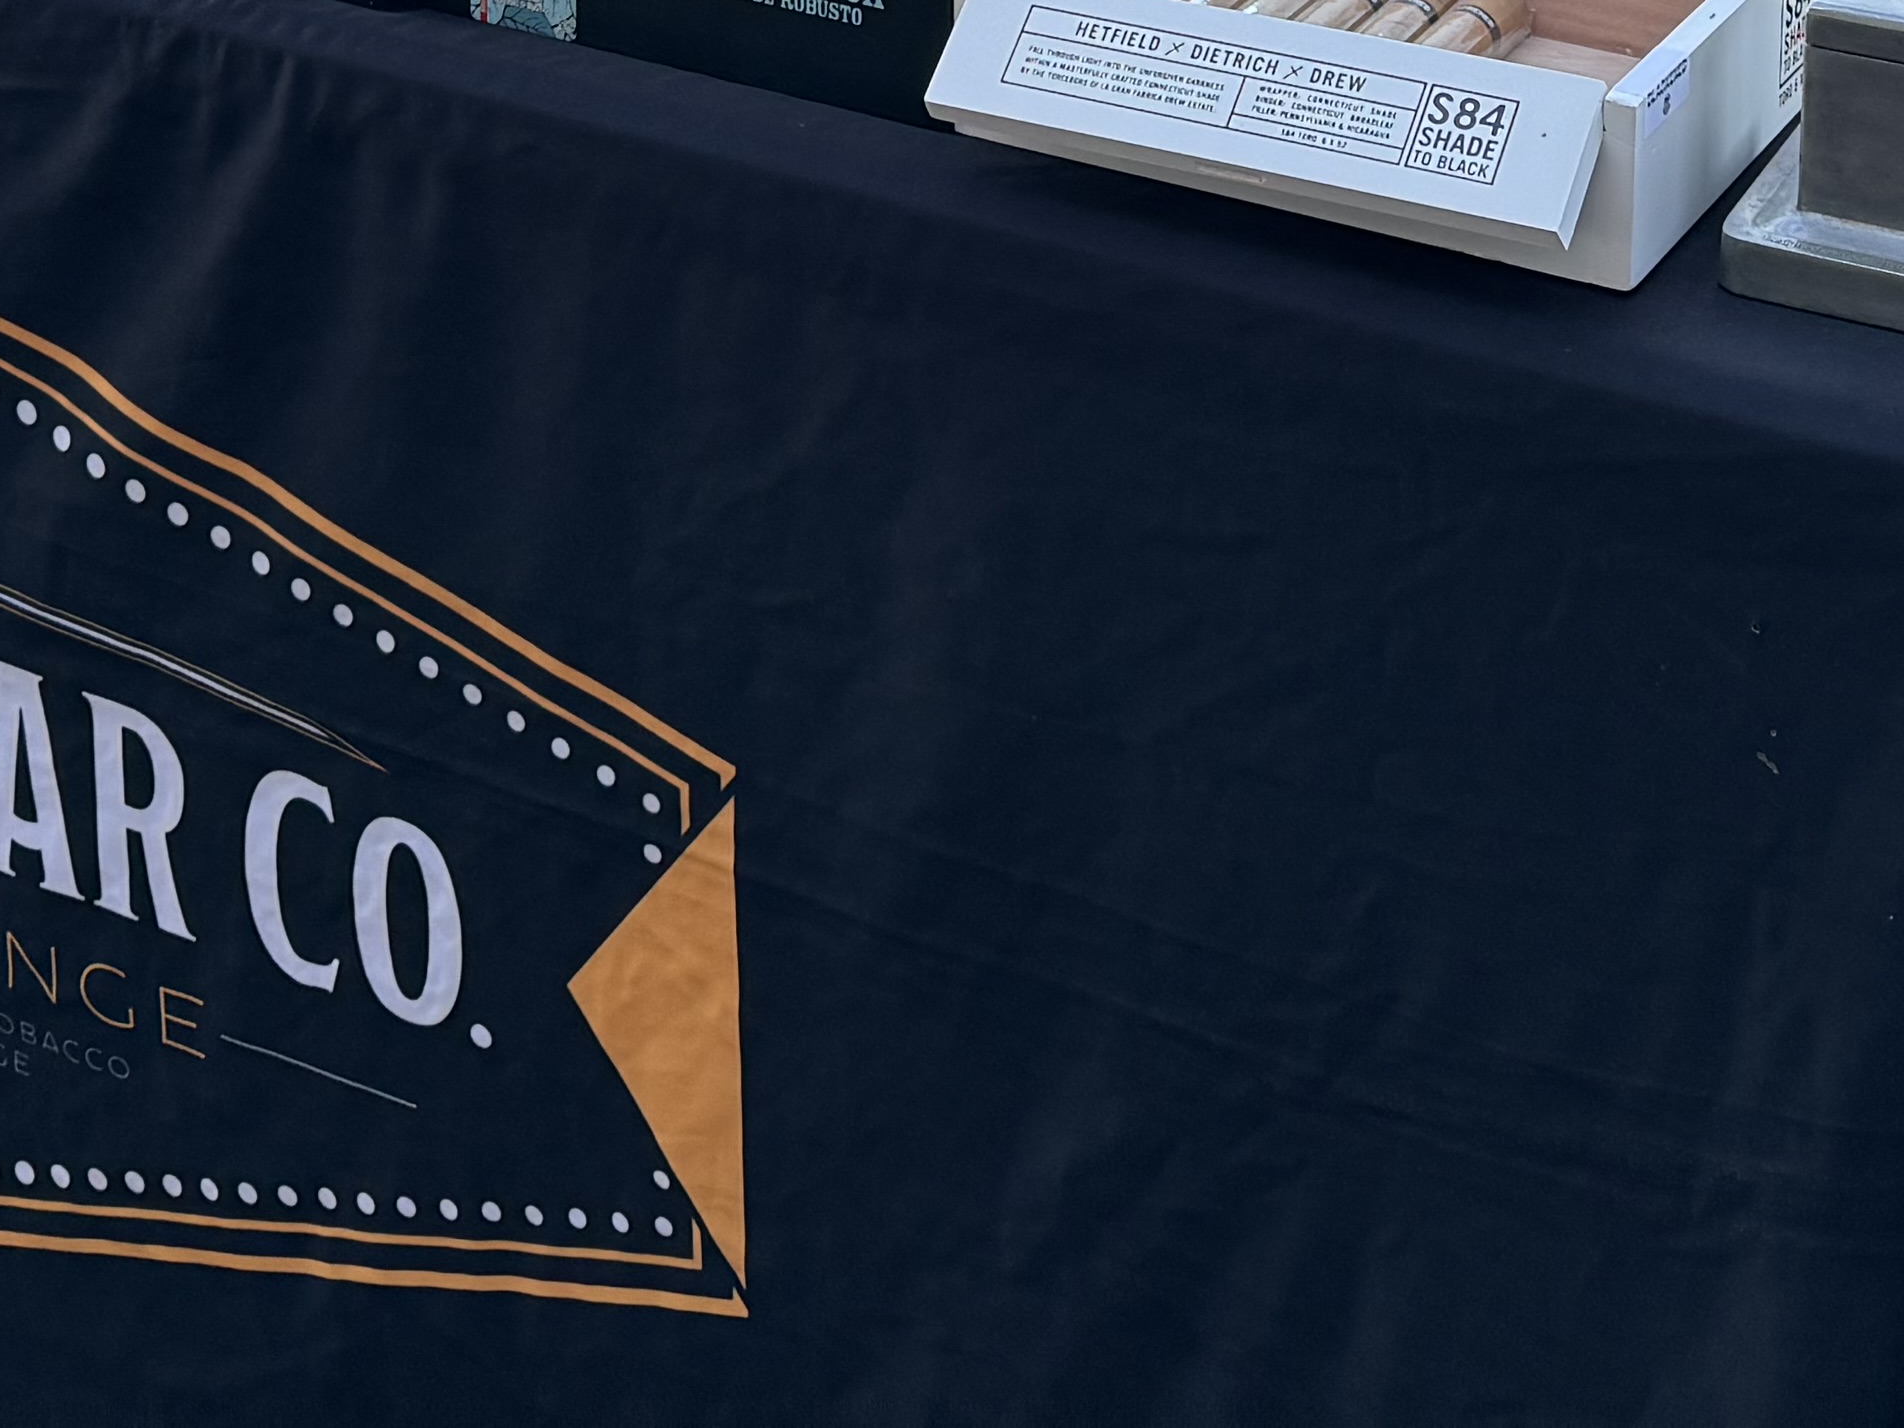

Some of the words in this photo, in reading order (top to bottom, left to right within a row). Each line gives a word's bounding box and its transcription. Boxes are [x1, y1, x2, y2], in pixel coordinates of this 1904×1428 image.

[1075, 20, 1162, 54] HETFIELD
[1190, 42, 1280, 78] DIETRICH
[1309, 67, 1368, 93] DREW
[1290, 101, 1345, 120] CONNECTICUT
[1307, 94, 1365, 113] CONNECTICUT
[1427, 91, 1506, 137] S84
[1418, 126, 1499, 162] SHADE
[1413, 149, 1433, 167] TO
[1437, 155, 1490, 180] BLACK
[241, 766, 496, 1052] CO.
